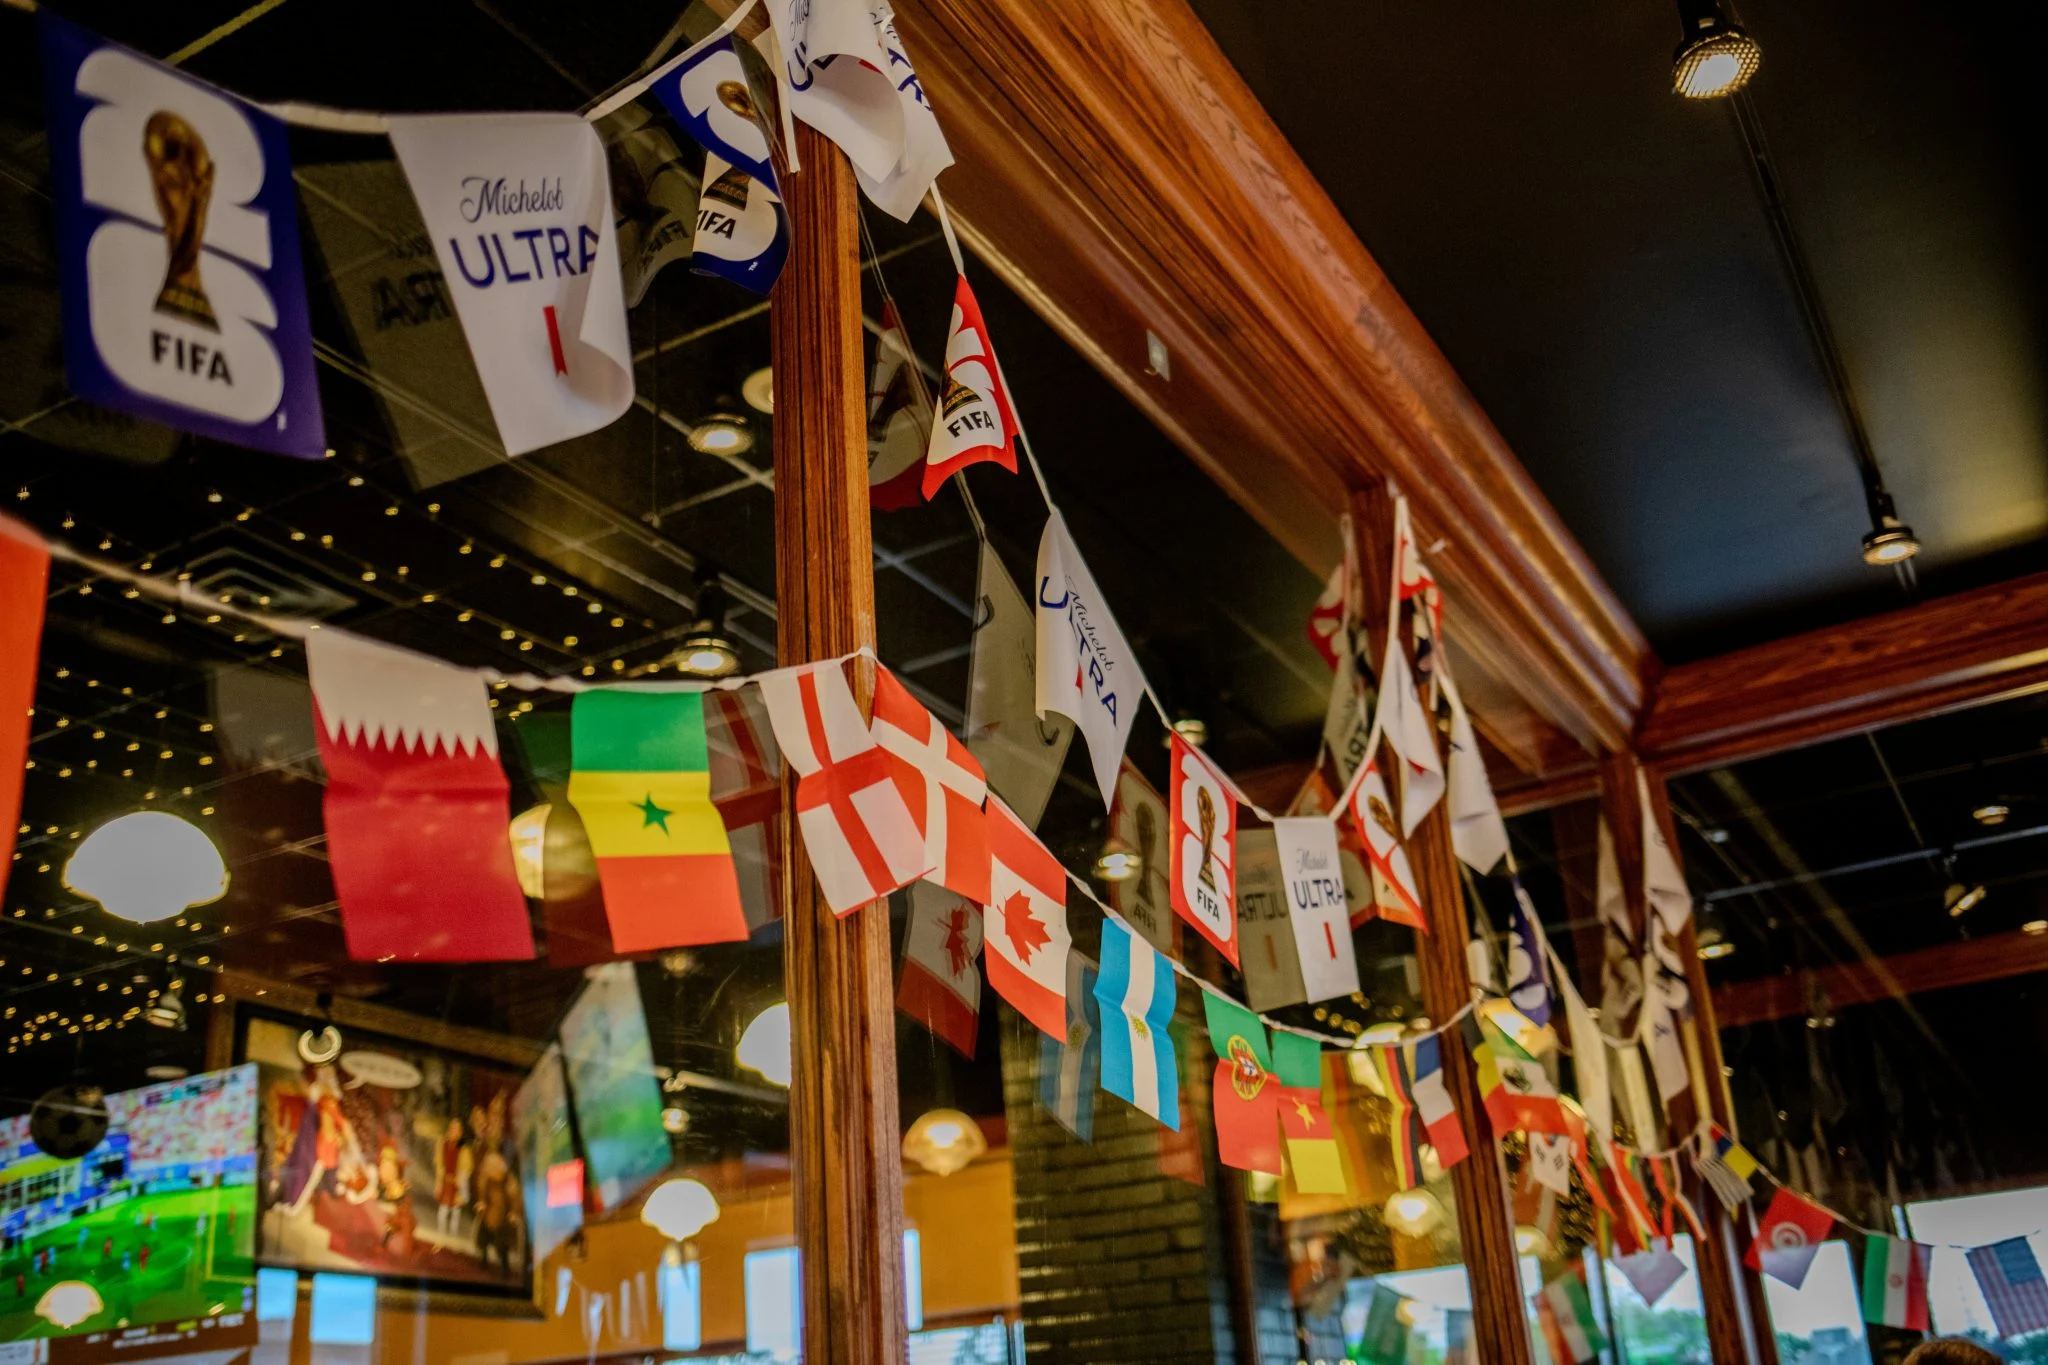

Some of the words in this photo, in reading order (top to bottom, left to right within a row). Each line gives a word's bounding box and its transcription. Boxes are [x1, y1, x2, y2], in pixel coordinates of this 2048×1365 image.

[459, 176, 564, 223] Michelob
[697, 209, 737, 240] IFA
[150, 329, 234, 387] FIFA
[946, 410, 995, 438] FIFA
[1196, 887, 1221, 923] FIFA
